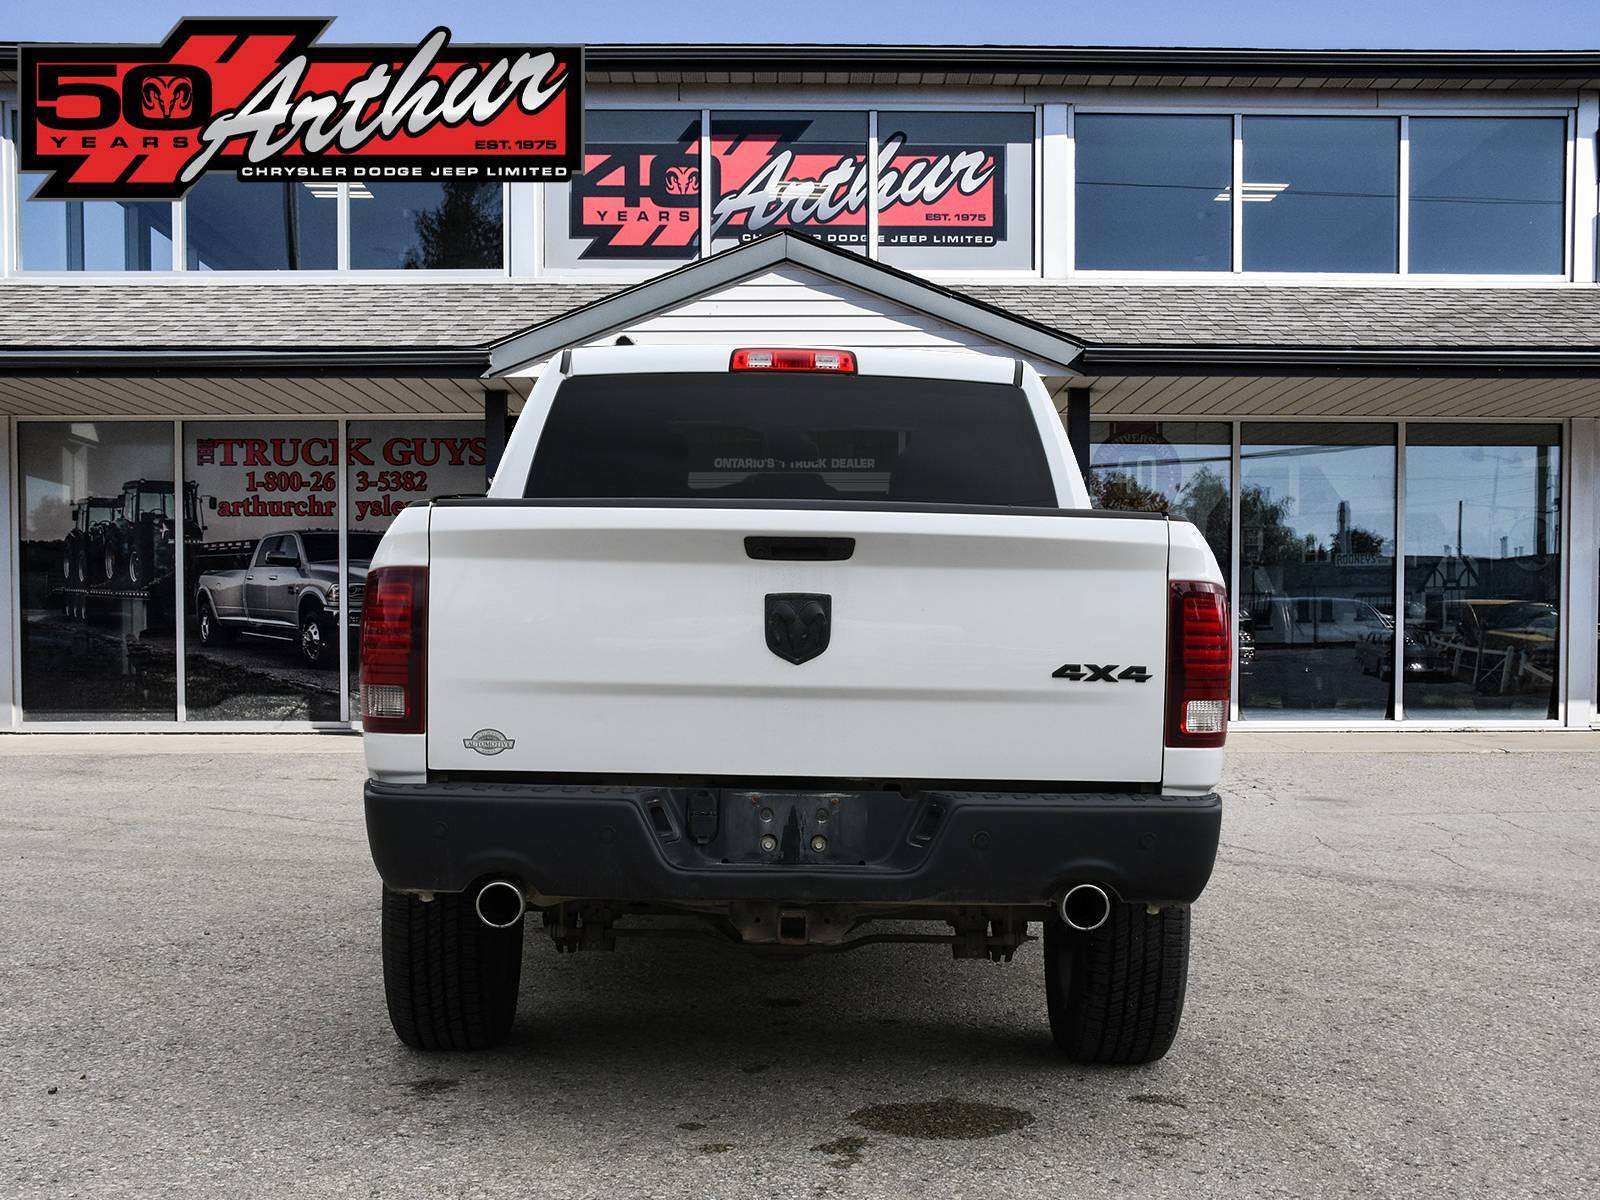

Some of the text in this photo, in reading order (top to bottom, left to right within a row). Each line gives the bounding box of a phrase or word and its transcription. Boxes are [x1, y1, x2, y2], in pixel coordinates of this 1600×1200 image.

[711, 135, 997, 236] Arthur
[596, 210, 690, 222] YEARS
[925, 213, 987, 222] EST. 1975
[890, 235, 927, 243] JEEP
[933, 235, 994, 244] LIMITED
[212, 438, 375, 466] TRUCK
[382, 437, 487, 466] GUYS
[831, 457, 876, 468] DEALER
[1051, 663, 1154, 683] 4X4
